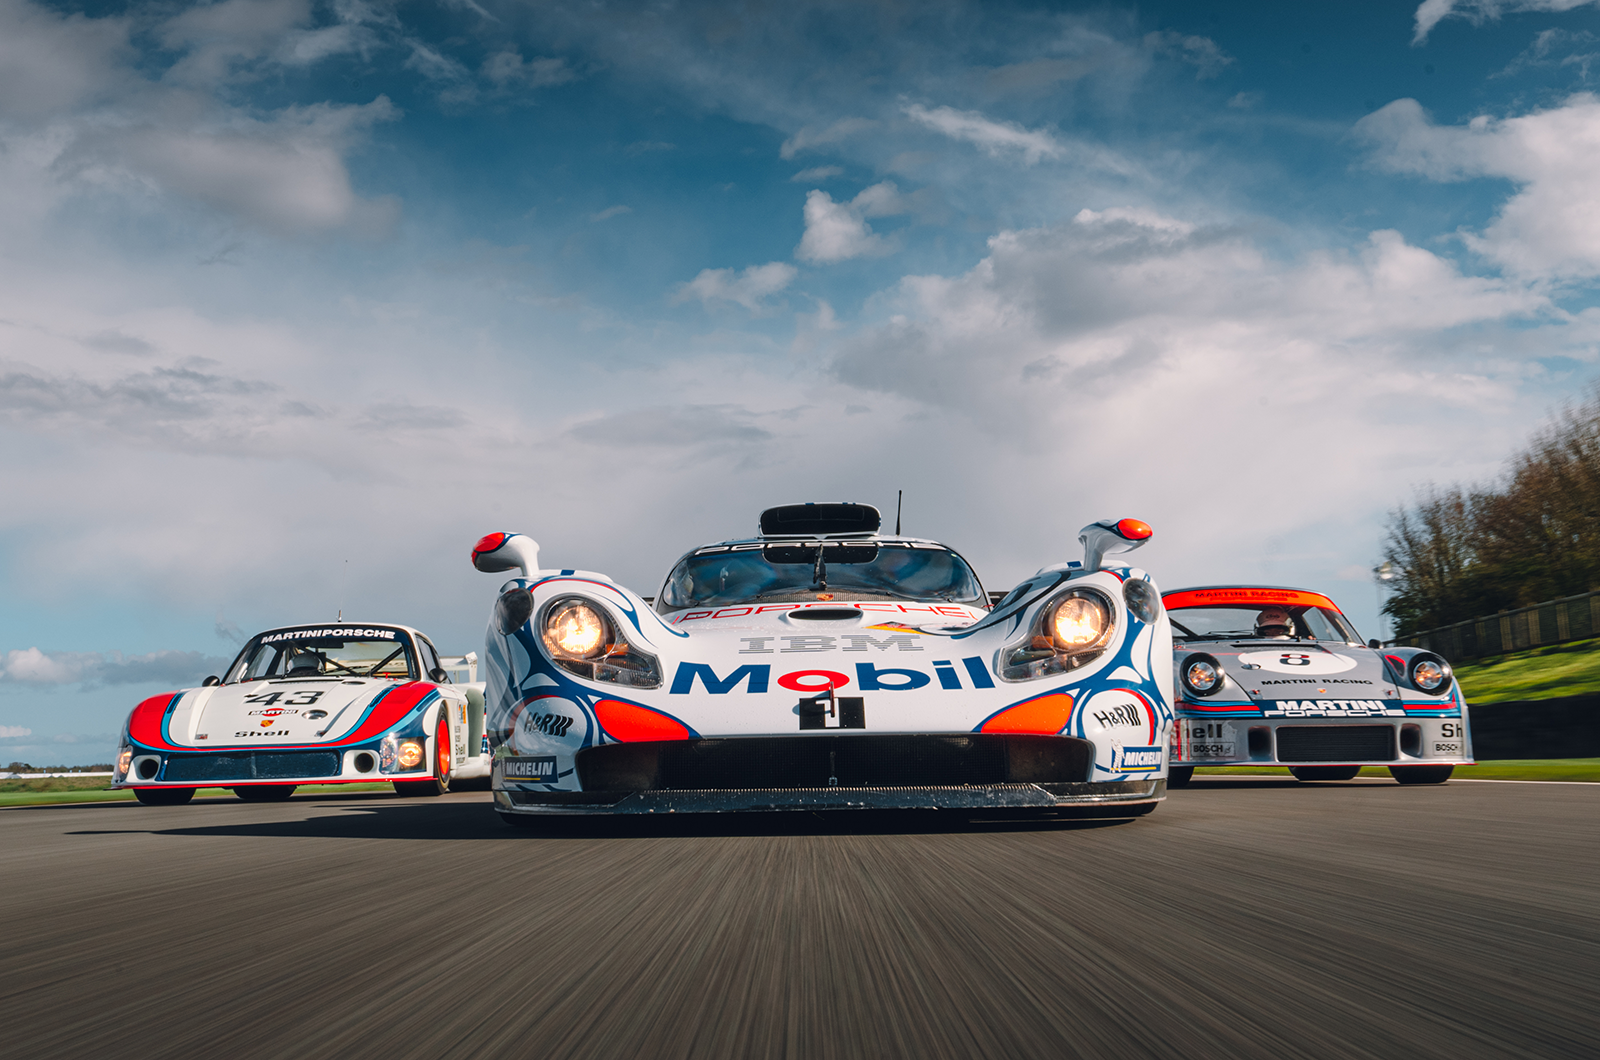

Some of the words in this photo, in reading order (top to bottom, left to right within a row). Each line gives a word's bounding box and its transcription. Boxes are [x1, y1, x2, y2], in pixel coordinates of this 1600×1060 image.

[694, 542, 947, 555] PORSCHE
[739, 635, 924, 654] IBM
[1280, 653, 1311, 666] 8
[669, 656, 996, 695] Mobil
[244, 691, 324, 706] 43
[1276, 700, 1387, 710] MARTINI
[815, 698, 840, 727] 1
[234, 730, 290, 738] Shell
[1193, 744, 1223, 752] BOSCH
[1435, 743, 1458, 751] BOSC
[505, 761, 554, 776] MICHELIN
